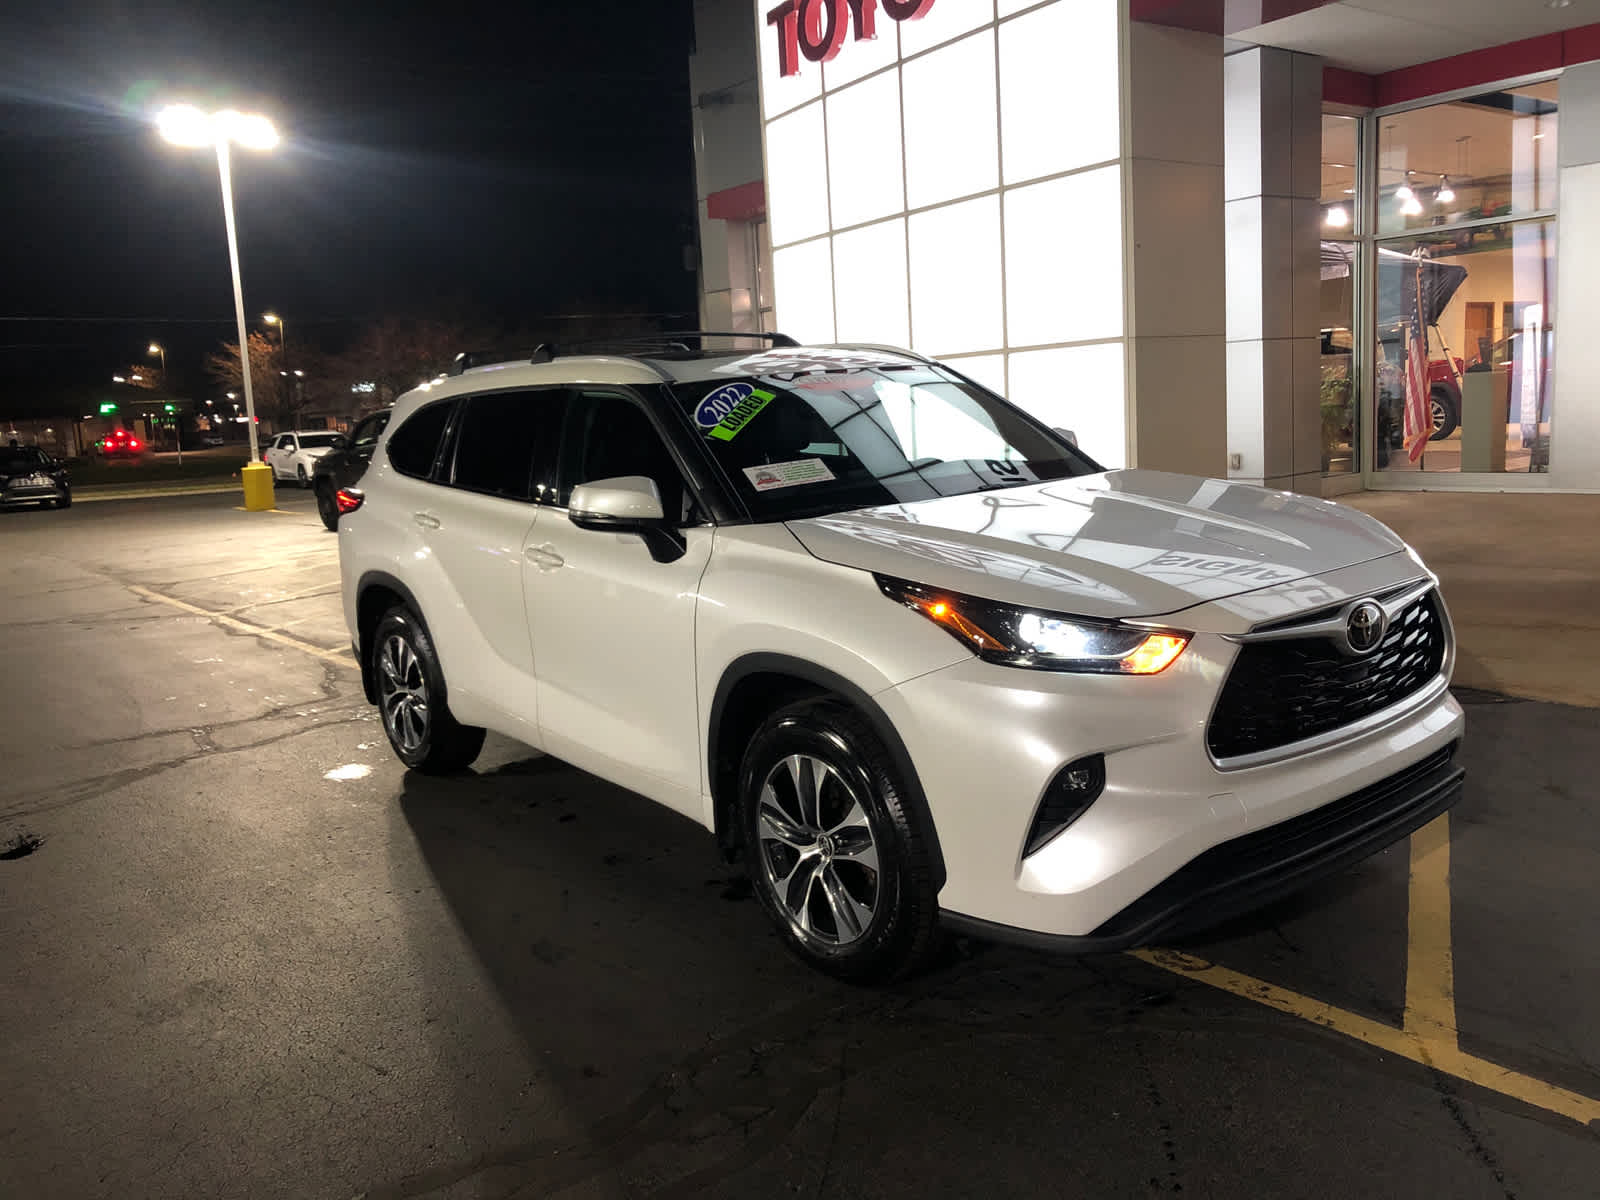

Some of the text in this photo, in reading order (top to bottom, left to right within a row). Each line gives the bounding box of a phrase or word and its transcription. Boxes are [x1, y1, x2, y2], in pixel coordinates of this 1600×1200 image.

[766, 0, 935, 77] TOY
[704, 387, 746, 421] 2022
[721, 396, 764, 431] LOADED
